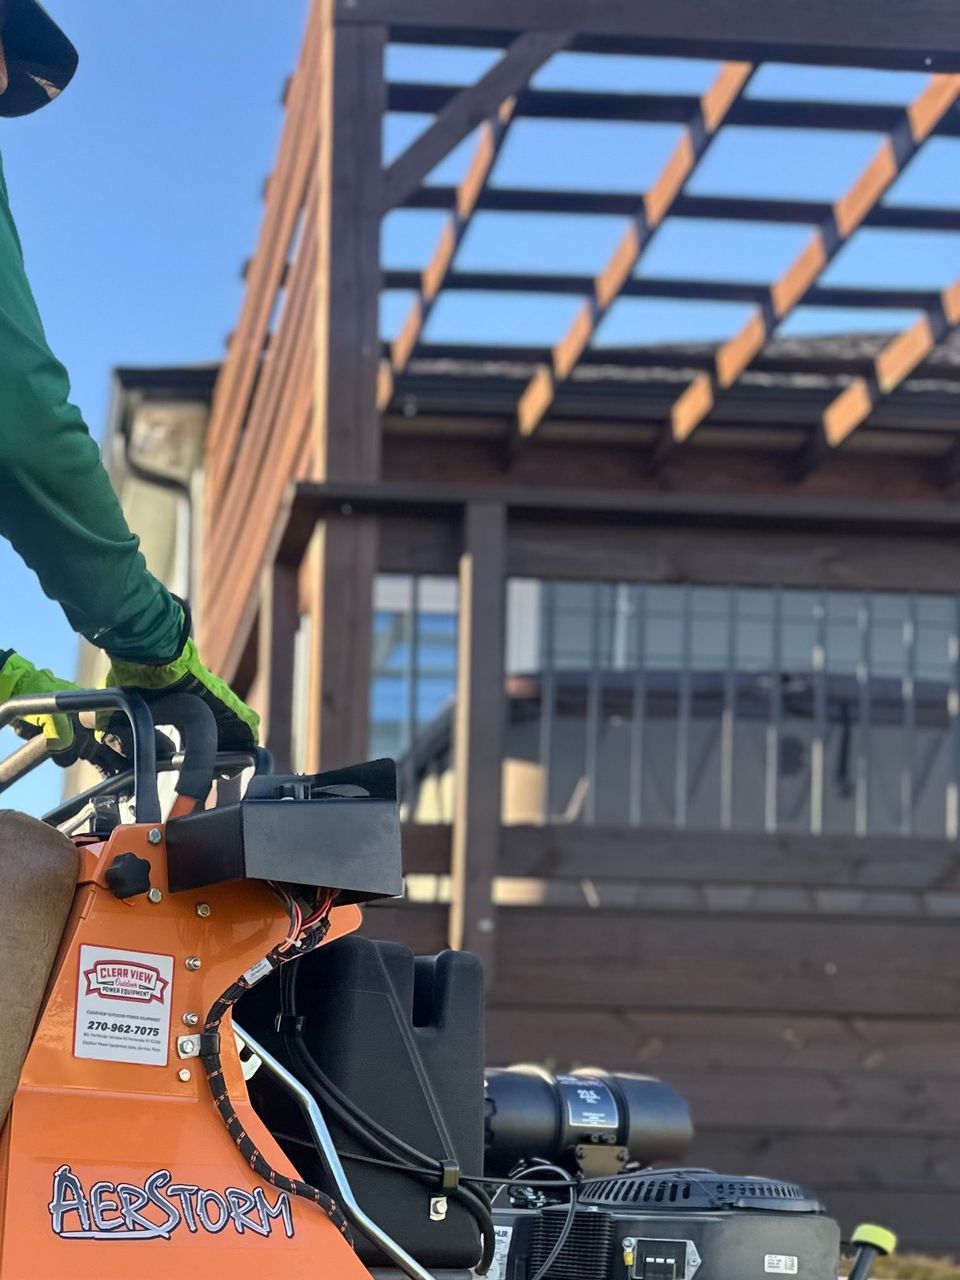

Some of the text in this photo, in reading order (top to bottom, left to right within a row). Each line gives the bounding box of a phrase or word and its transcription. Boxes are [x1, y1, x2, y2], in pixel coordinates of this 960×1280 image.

[100, 967, 153, 984] CLEAR VIEW
[102, 986, 150, 998] POWER EQUIPMENT
[87, 1021, 160, 1037] 270-962-7075
